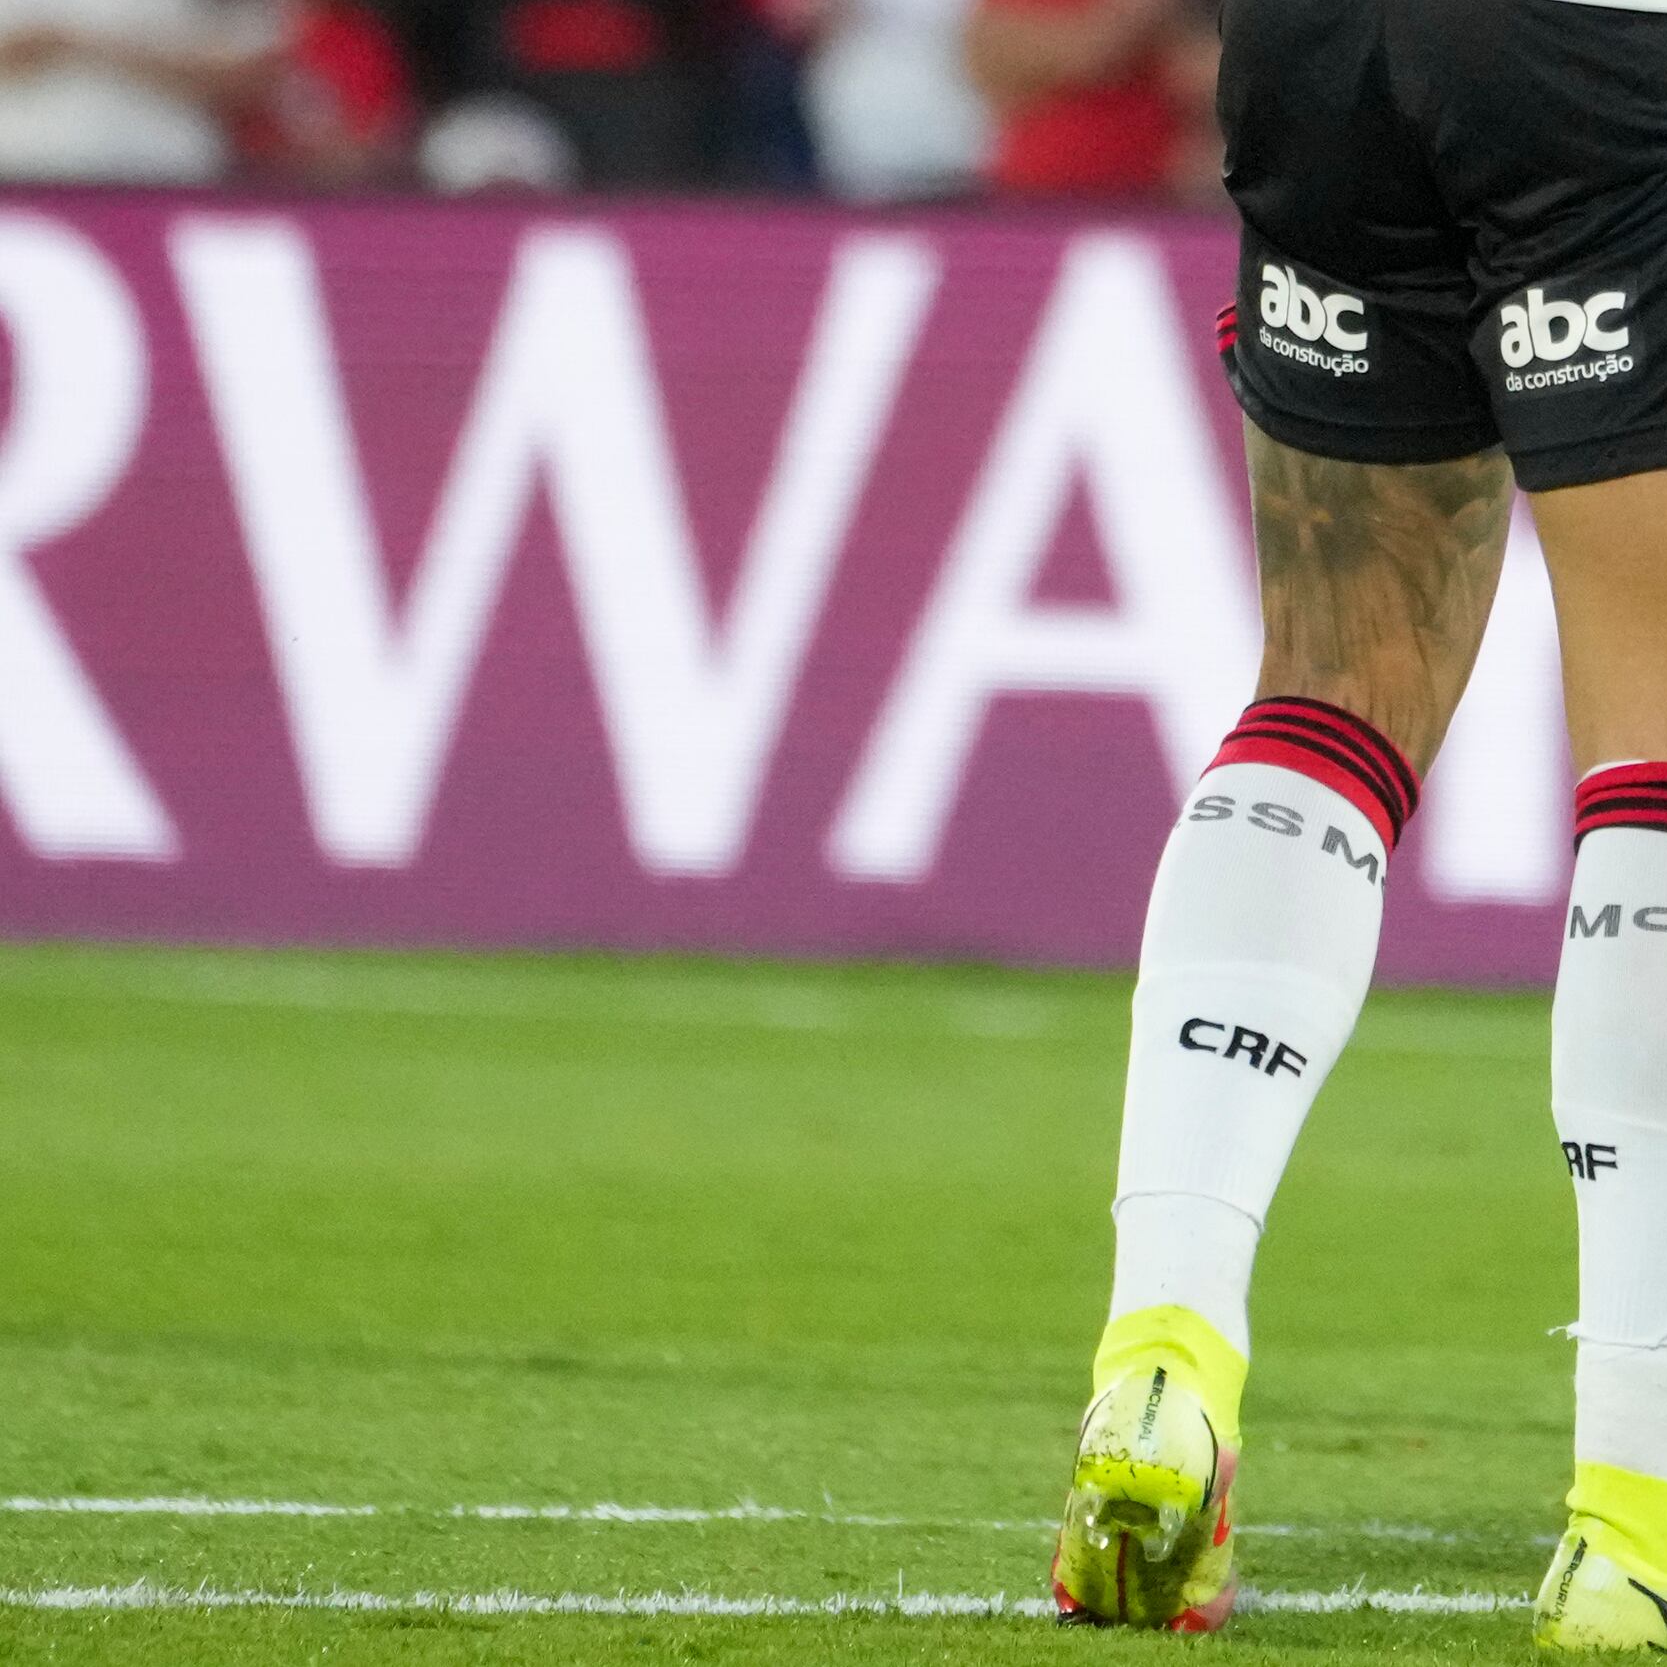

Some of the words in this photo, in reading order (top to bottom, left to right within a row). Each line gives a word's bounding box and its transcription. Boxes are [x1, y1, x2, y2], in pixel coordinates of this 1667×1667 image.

[1261, 264, 1368, 352] abc
[1500, 288, 1629, 368] abc
[1259, 326, 1272, 349] da
[1273, 337, 1369, 377] construção
[1505, 372, 1523, 392] da
[1524, 354, 1633, 390] construção
[1178, 1017, 1308, 1078] CRF
[1137, 1365, 1168, 1443] MERCURIAL
